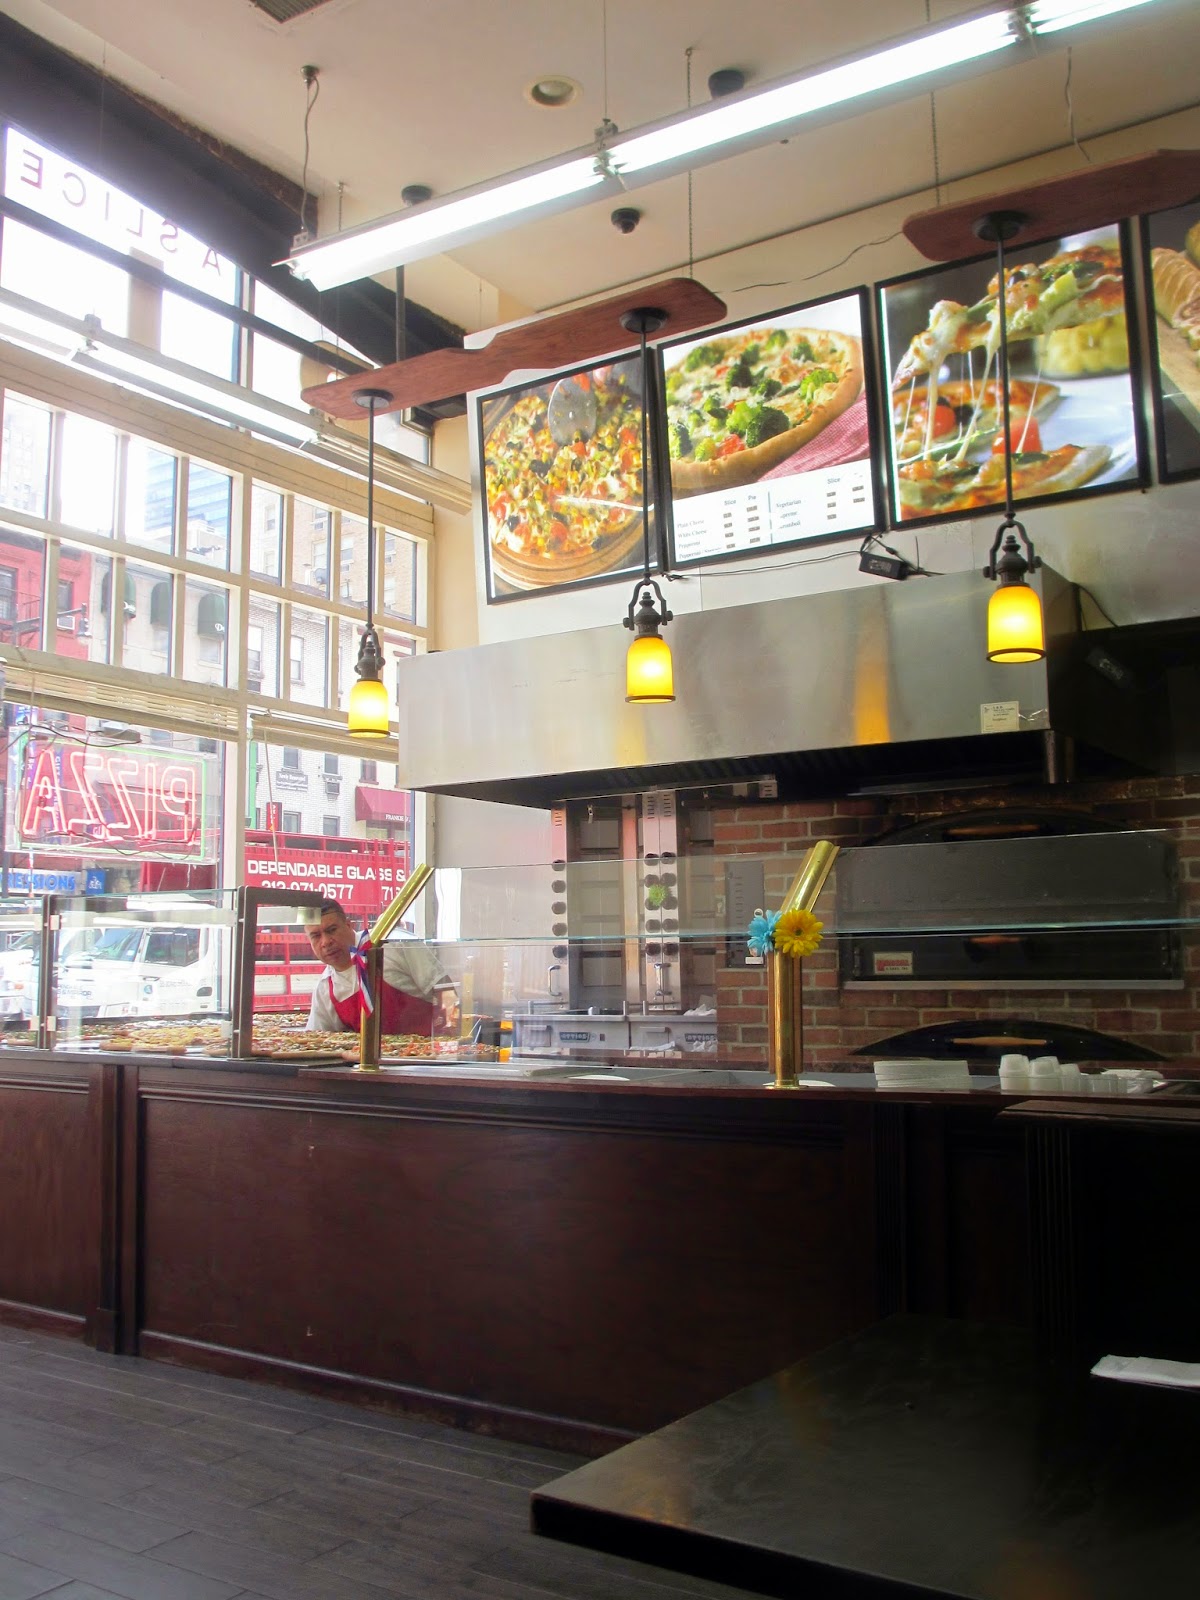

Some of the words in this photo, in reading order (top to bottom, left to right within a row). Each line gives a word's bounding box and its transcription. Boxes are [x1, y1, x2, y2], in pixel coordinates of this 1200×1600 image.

[247, 860, 343, 879] DEPENDABLE
[346, 866, 393, 882] GLASS
[395, 869, 406, 882] &
